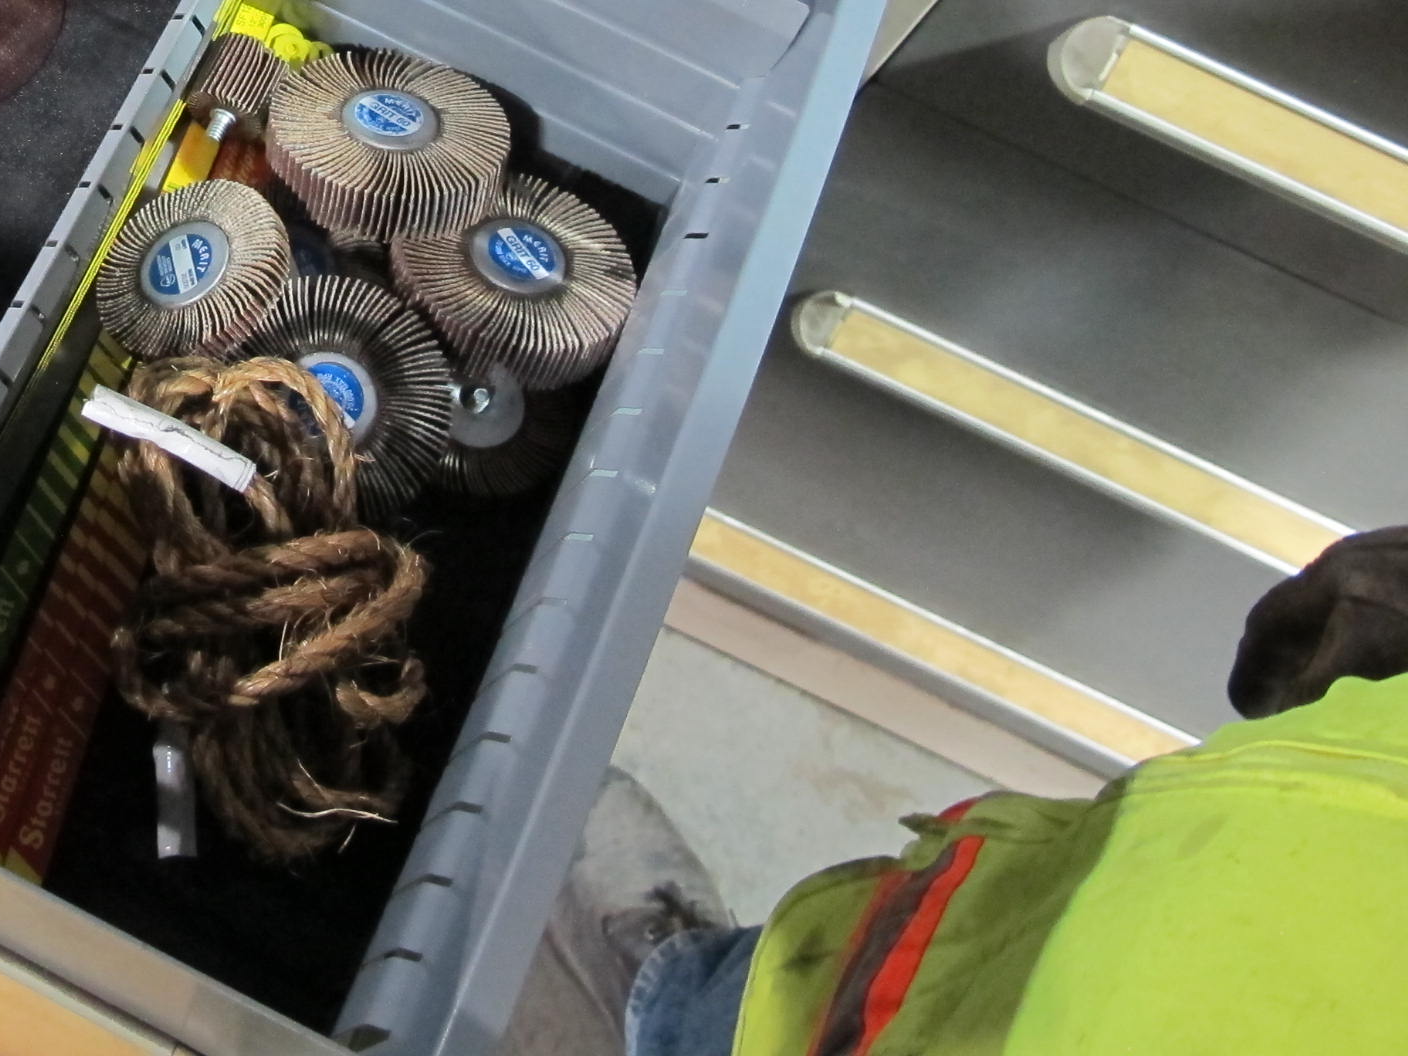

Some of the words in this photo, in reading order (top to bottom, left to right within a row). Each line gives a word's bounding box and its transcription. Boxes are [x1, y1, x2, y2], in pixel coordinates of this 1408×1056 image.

[371, 101, 396, 121] GRIT
[191, 238, 211, 273] MERIT
[506, 235, 530, 259] GRIT
[526, 258, 540, 272] 60
[522, 233, 550, 264] MERIT
[20, 736, 74, 851] Starrett
